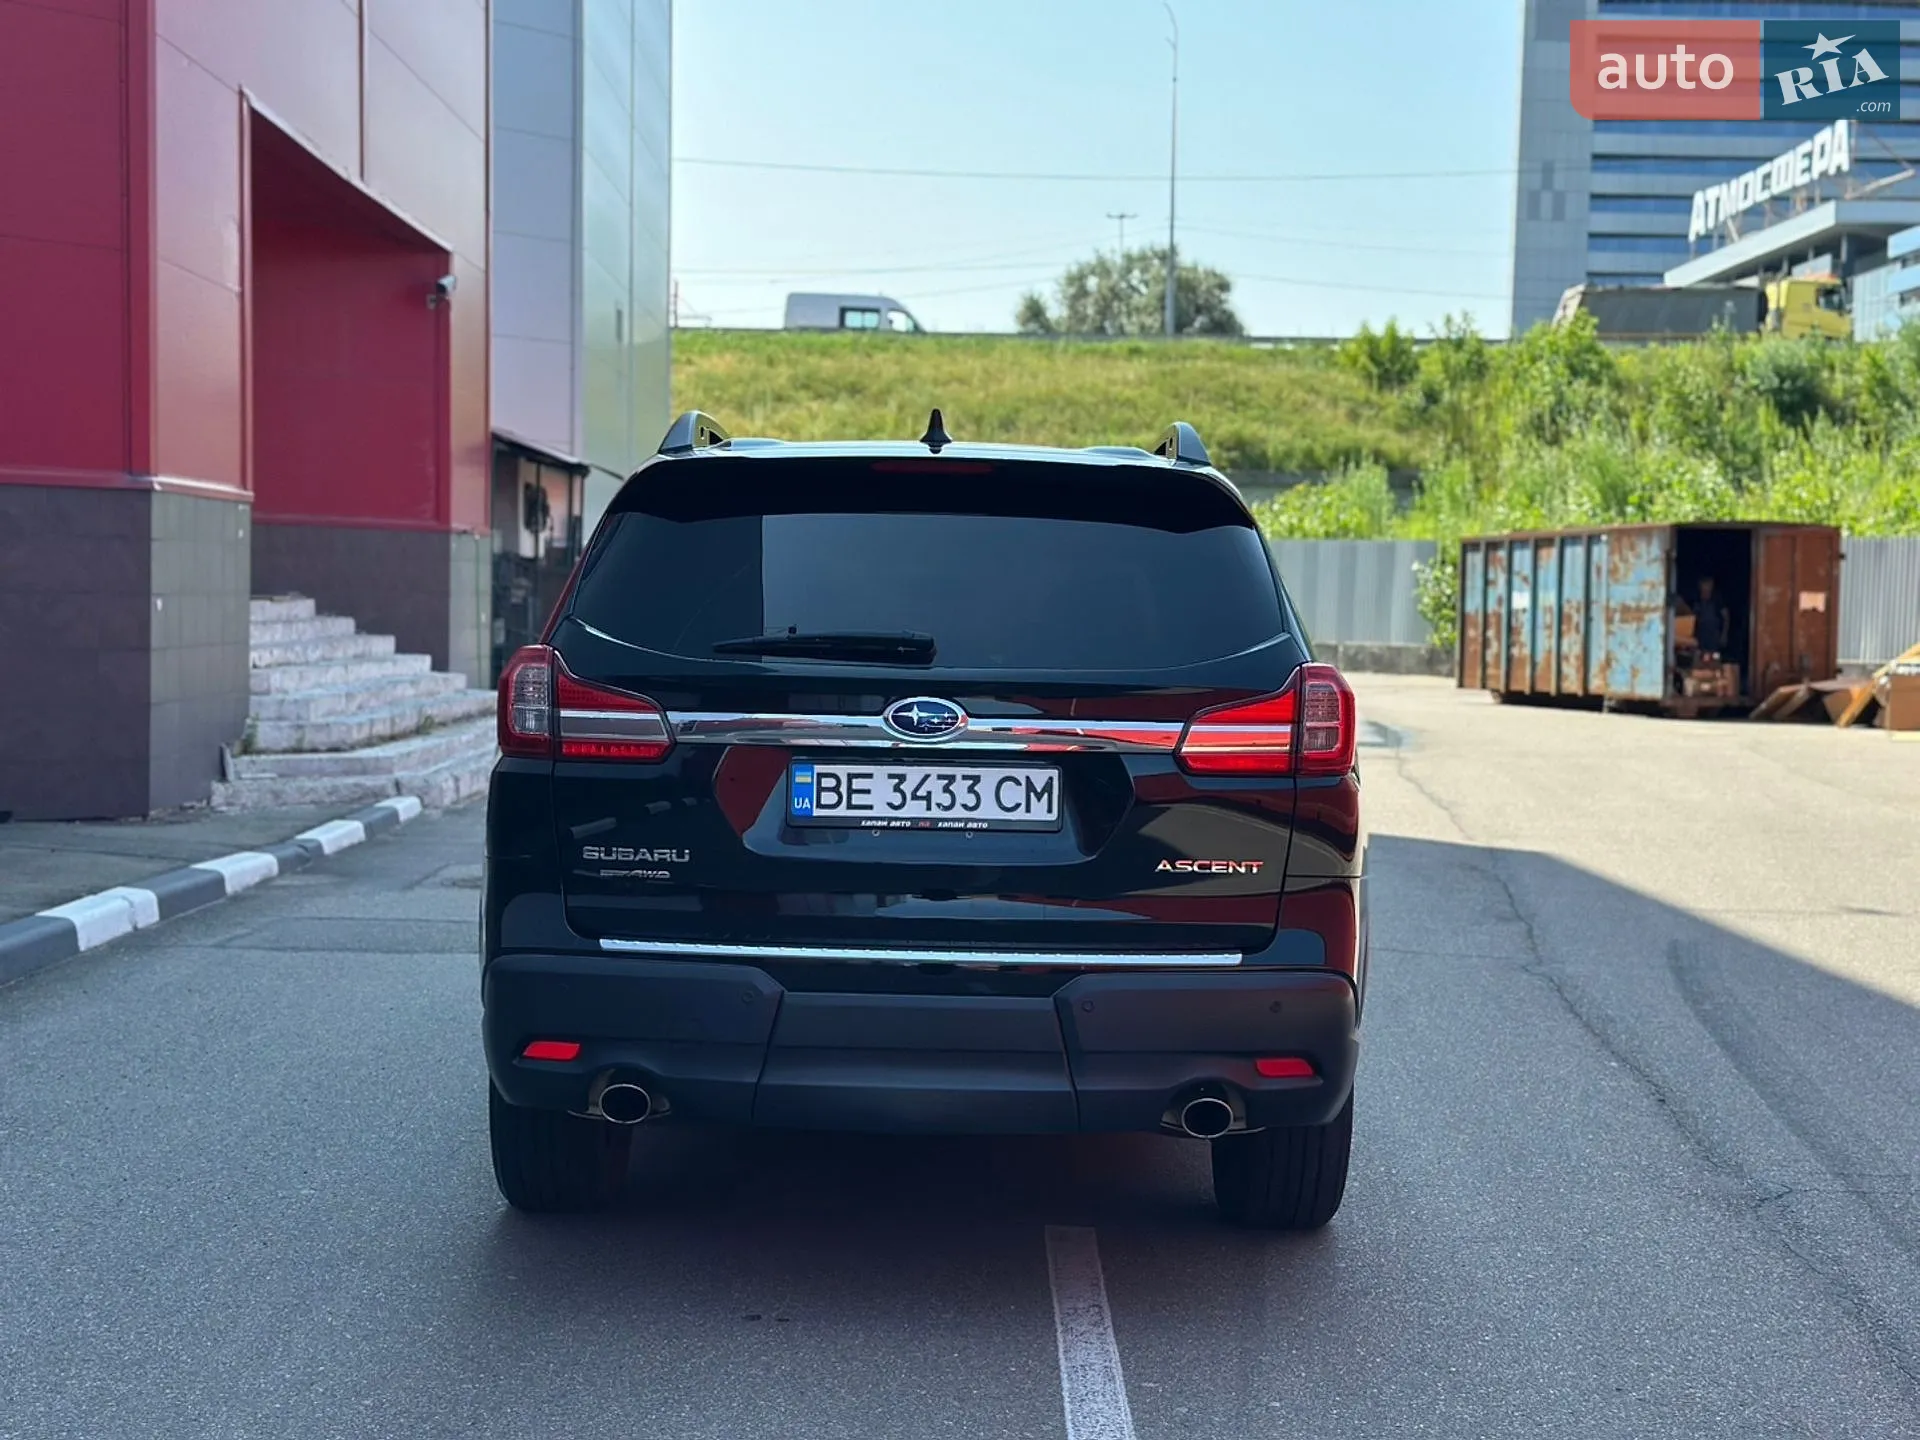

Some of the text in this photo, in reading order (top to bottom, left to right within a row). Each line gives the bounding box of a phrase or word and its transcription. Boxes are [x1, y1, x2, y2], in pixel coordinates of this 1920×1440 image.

[1688, 119, 1850, 243] АТМОСФЕРА
[815, 772, 1054, 814] BE 3433 CM
[794, 797, 811, 809] UA
[582, 846, 690, 862] SUBARU
[1155, 859, 1264, 874] ASCENT
